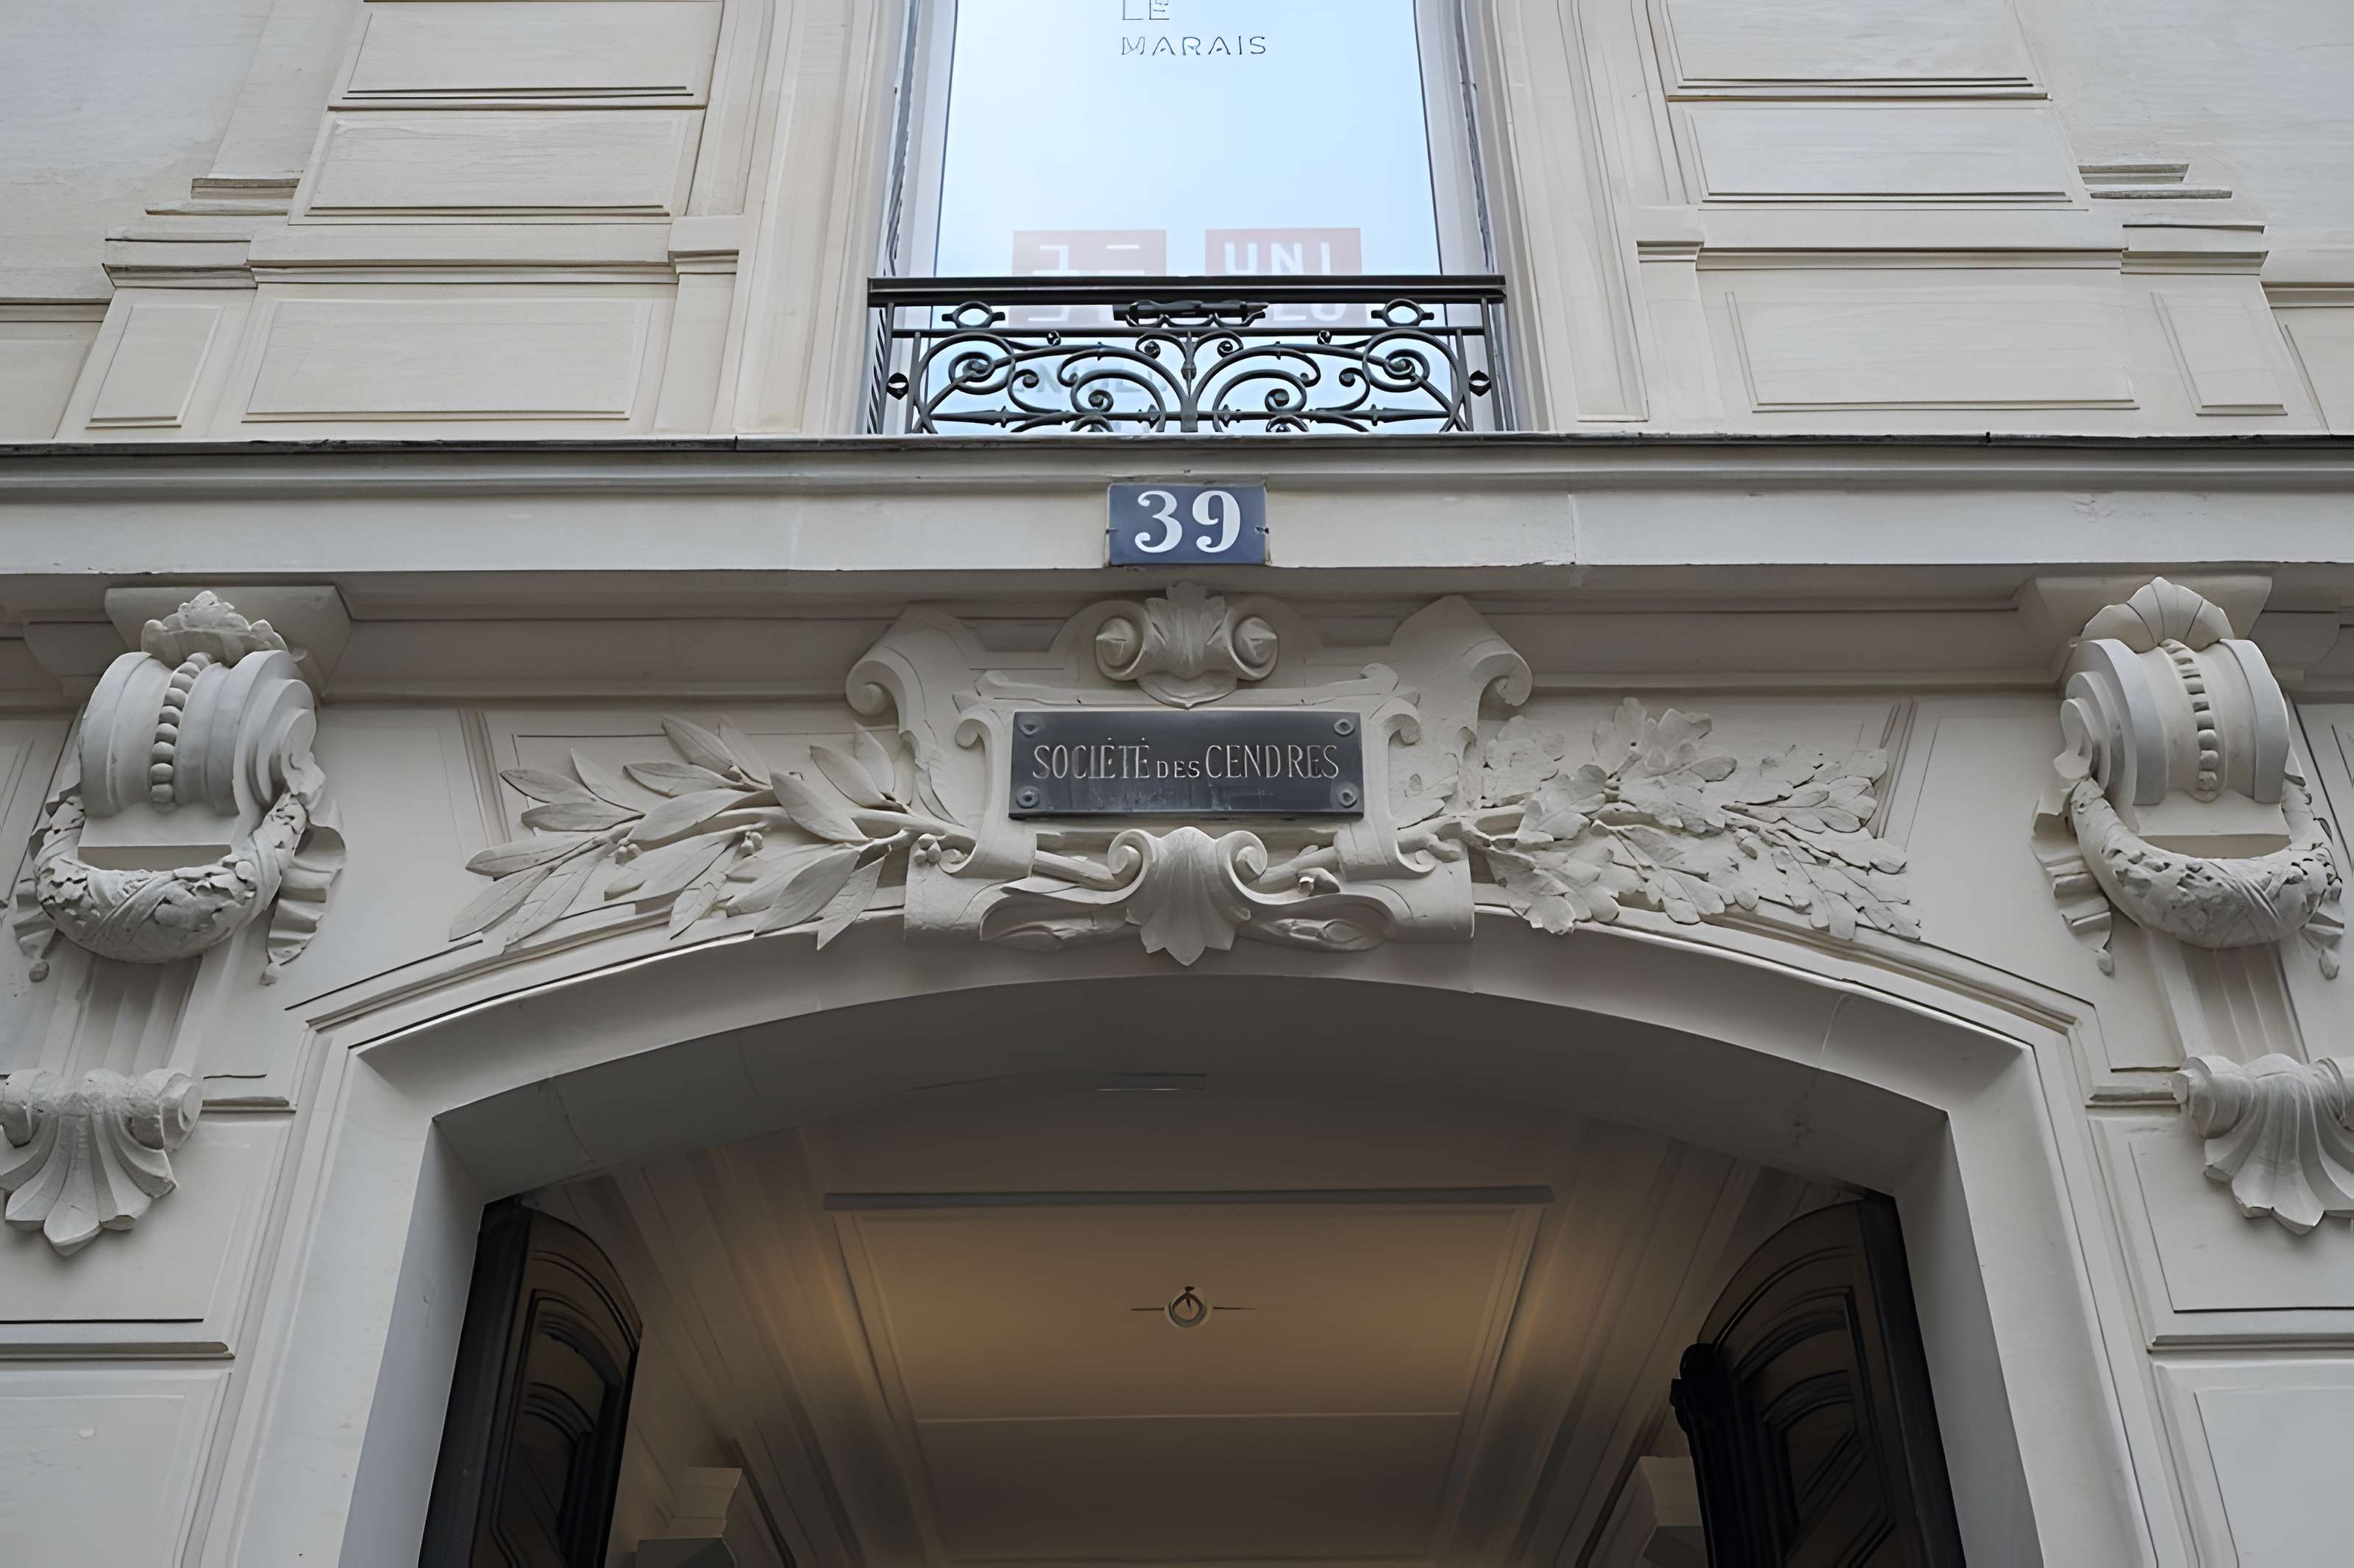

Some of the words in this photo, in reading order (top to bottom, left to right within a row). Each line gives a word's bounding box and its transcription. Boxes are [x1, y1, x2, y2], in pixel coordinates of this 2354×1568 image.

[1121, 36, 1266, 55] MARAIS
[1134, 489, 1242, 553] 39
[1033, 737, 1150, 779] SOCIÉTÉ
[1156, 760, 1200, 779] DES
[1206, 744, 1339, 779] CENDRES
